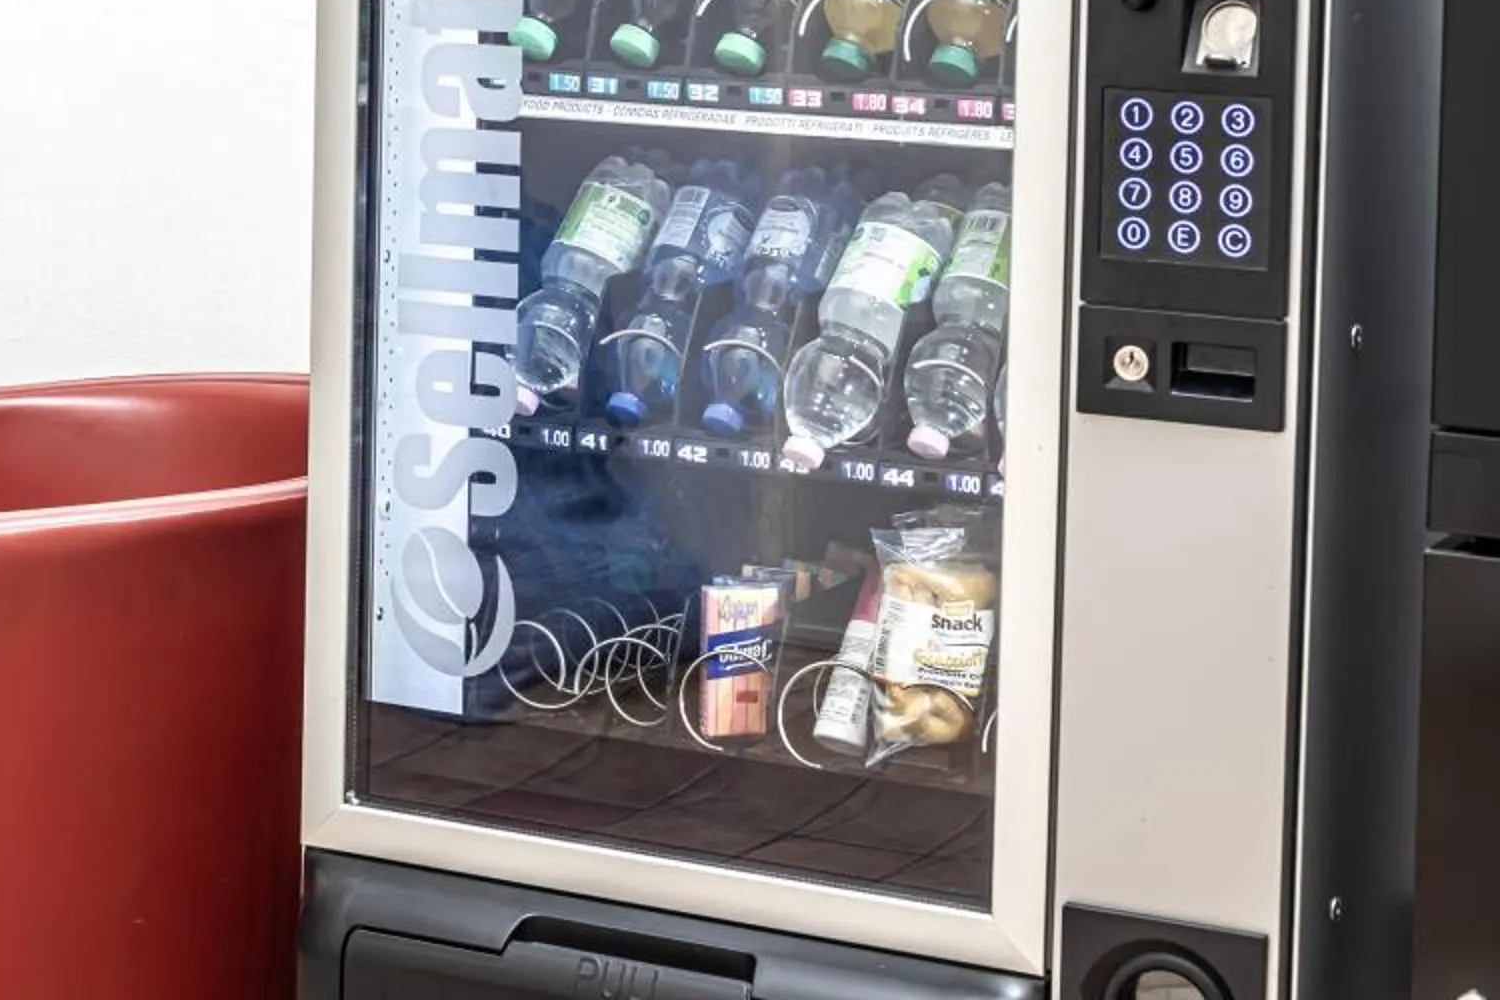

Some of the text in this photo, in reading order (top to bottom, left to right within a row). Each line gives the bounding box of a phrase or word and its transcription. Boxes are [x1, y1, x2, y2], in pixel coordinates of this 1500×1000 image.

[551, 73, 581, 93] 1.50
[589, 77, 619, 95] 31
[649, 81, 680, 100] 1.50
[688, 83, 719, 102] 32
[750, 87, 783, 106] 1.50
[790, 89, 822, 108] 33
[854, 93, 886, 112] 1.80
[892, 96, 926, 115] 34
[958, 100, 993, 119] 1.80
[1131, 105, 1245, 131] 1 2 3
[1128, 145, 1245, 170] 4 5 6
[1128, 184, 1243, 210] 7 8 9
[1127, 223, 1243, 251] 0 E C
[542, 429, 571, 447] 1.00
[580, 433, 608, 451] 41
[641, 439, 671, 457] 1.00
[677, 445, 708, 463] 42
[740, 450, 771, 469] 1.00
[843, 461, 874, 481] 1.00
[882, 467, 915, 487] 44
[949, 474, 980, 494] 1.00
